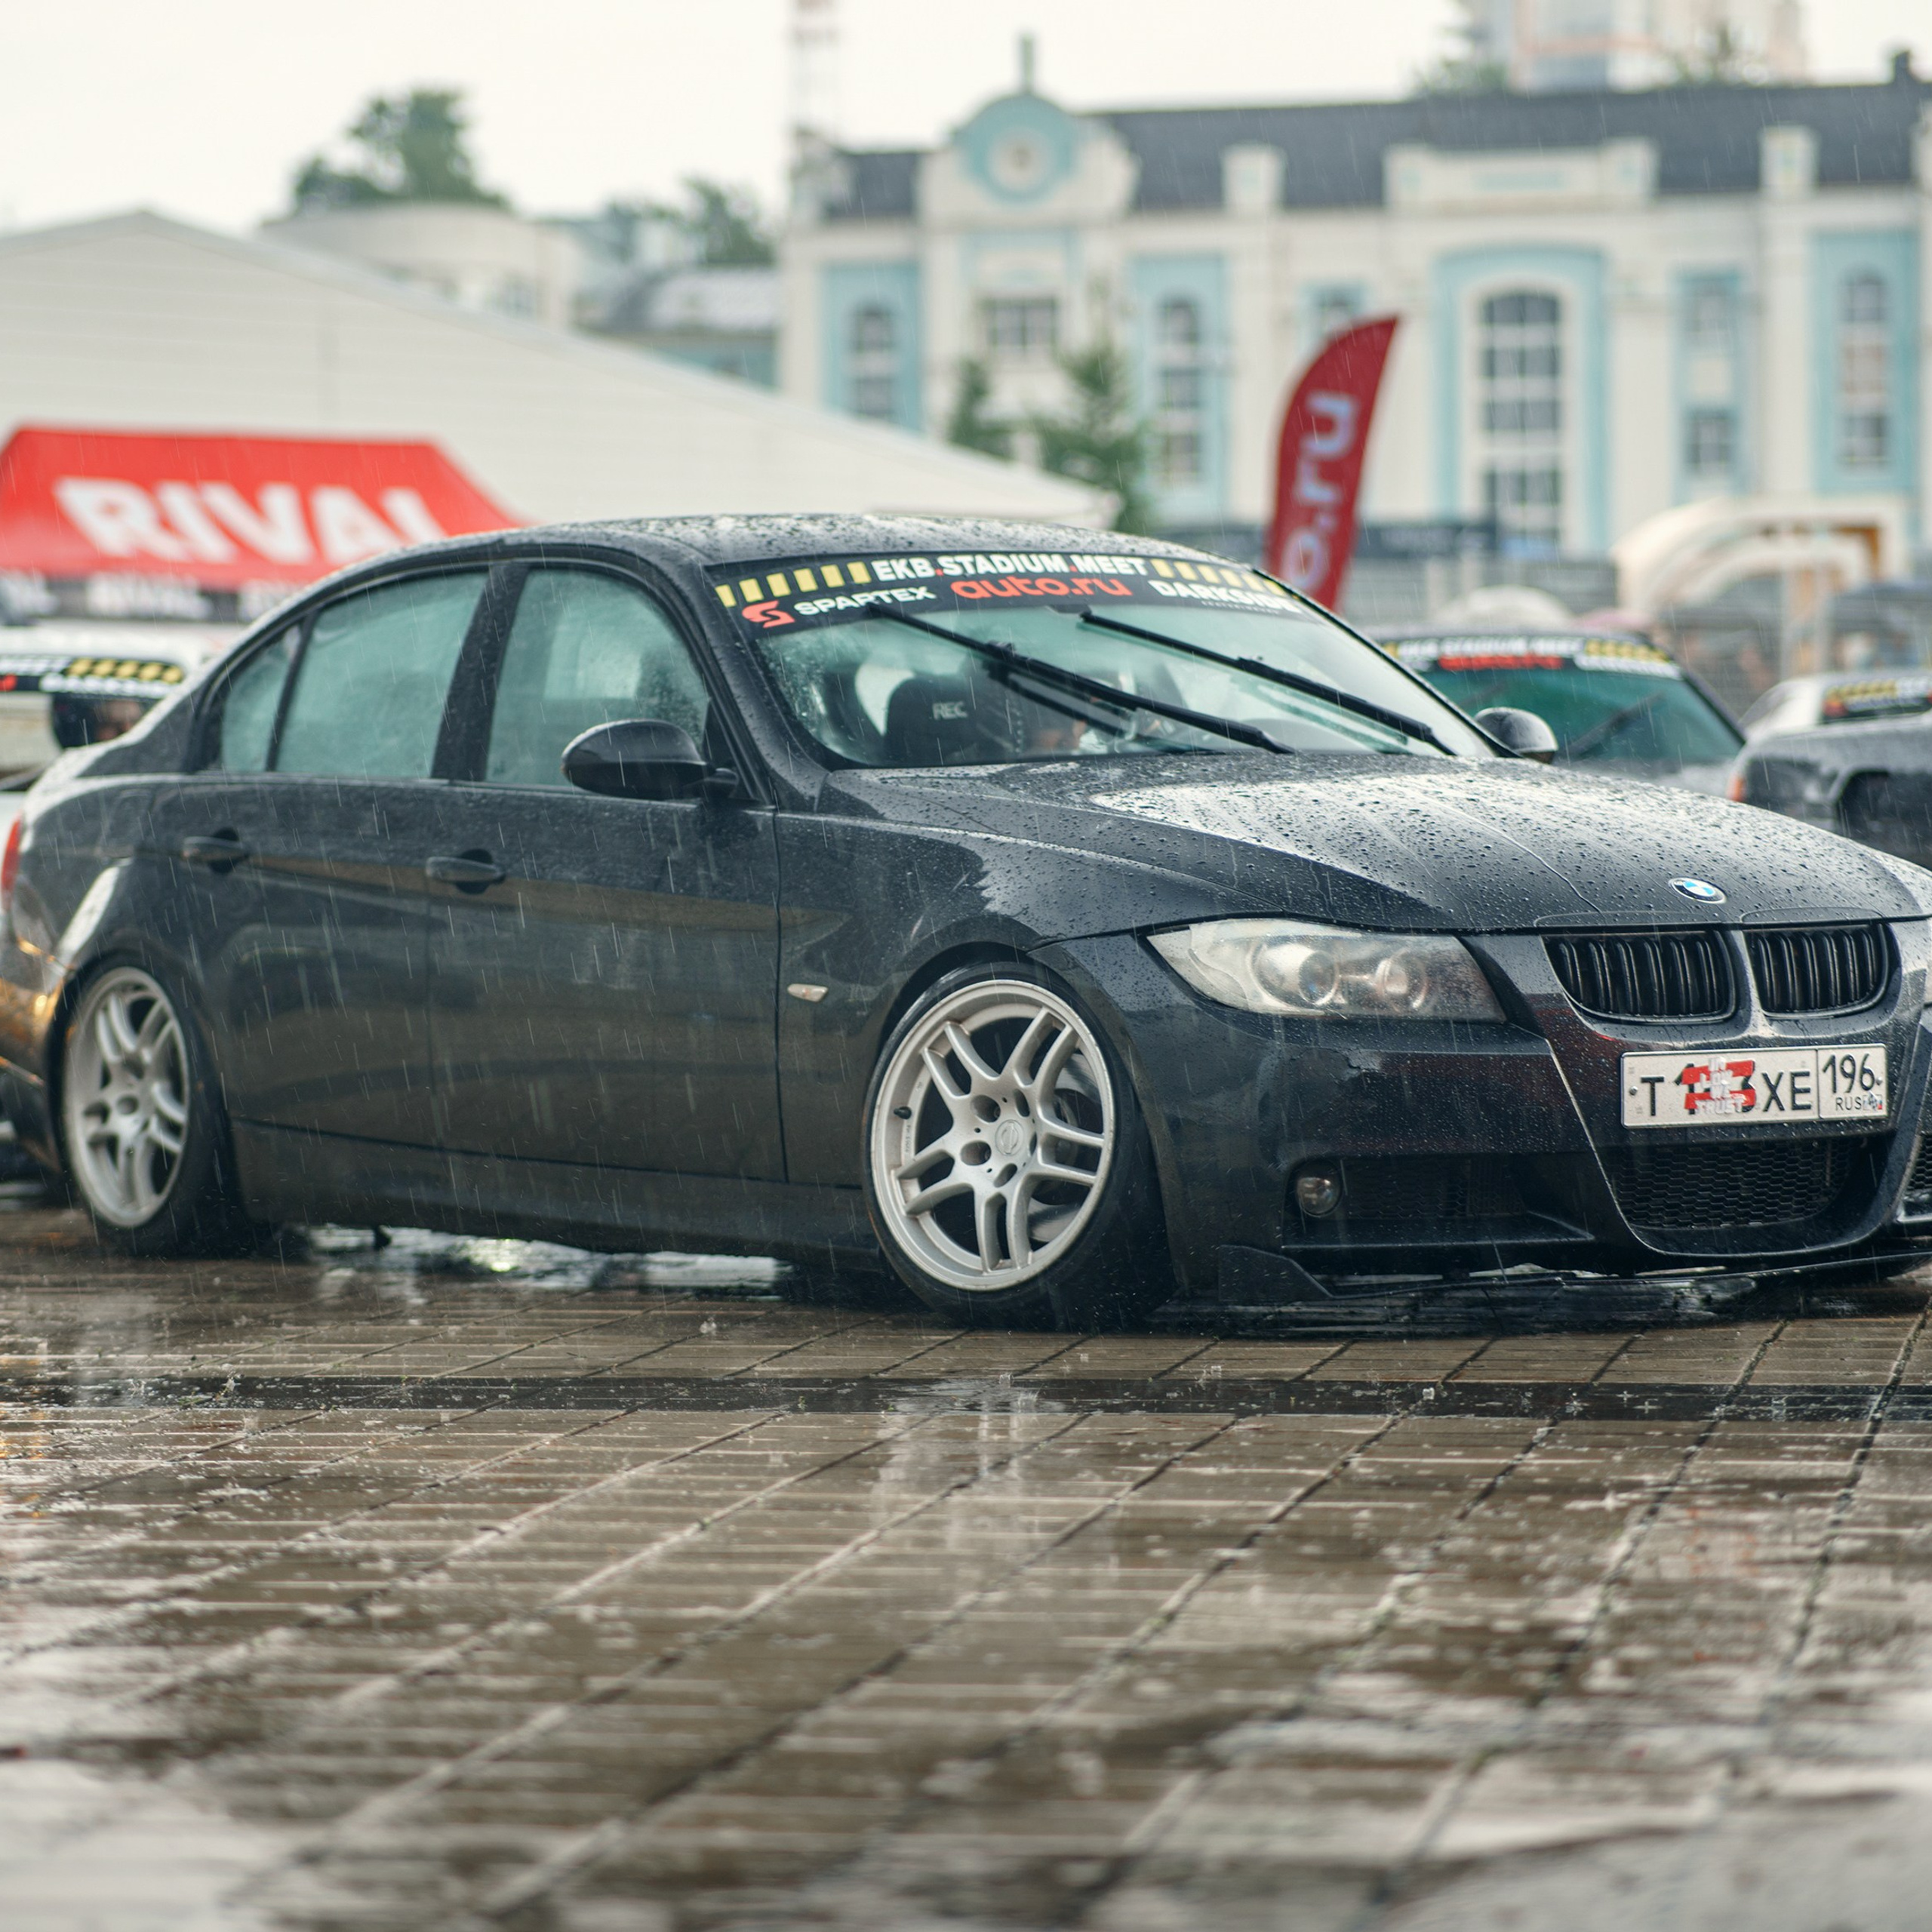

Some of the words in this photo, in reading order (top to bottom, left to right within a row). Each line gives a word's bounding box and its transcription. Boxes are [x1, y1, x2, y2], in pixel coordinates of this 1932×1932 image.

[950, 576, 1133, 599] auto.ru
[794, 586, 937, 616] SPARTEX
[932, 701, 968, 720] REC
[1823, 1054, 1875, 1094] 196
[1835, 1097, 1863, 1111] RUS
